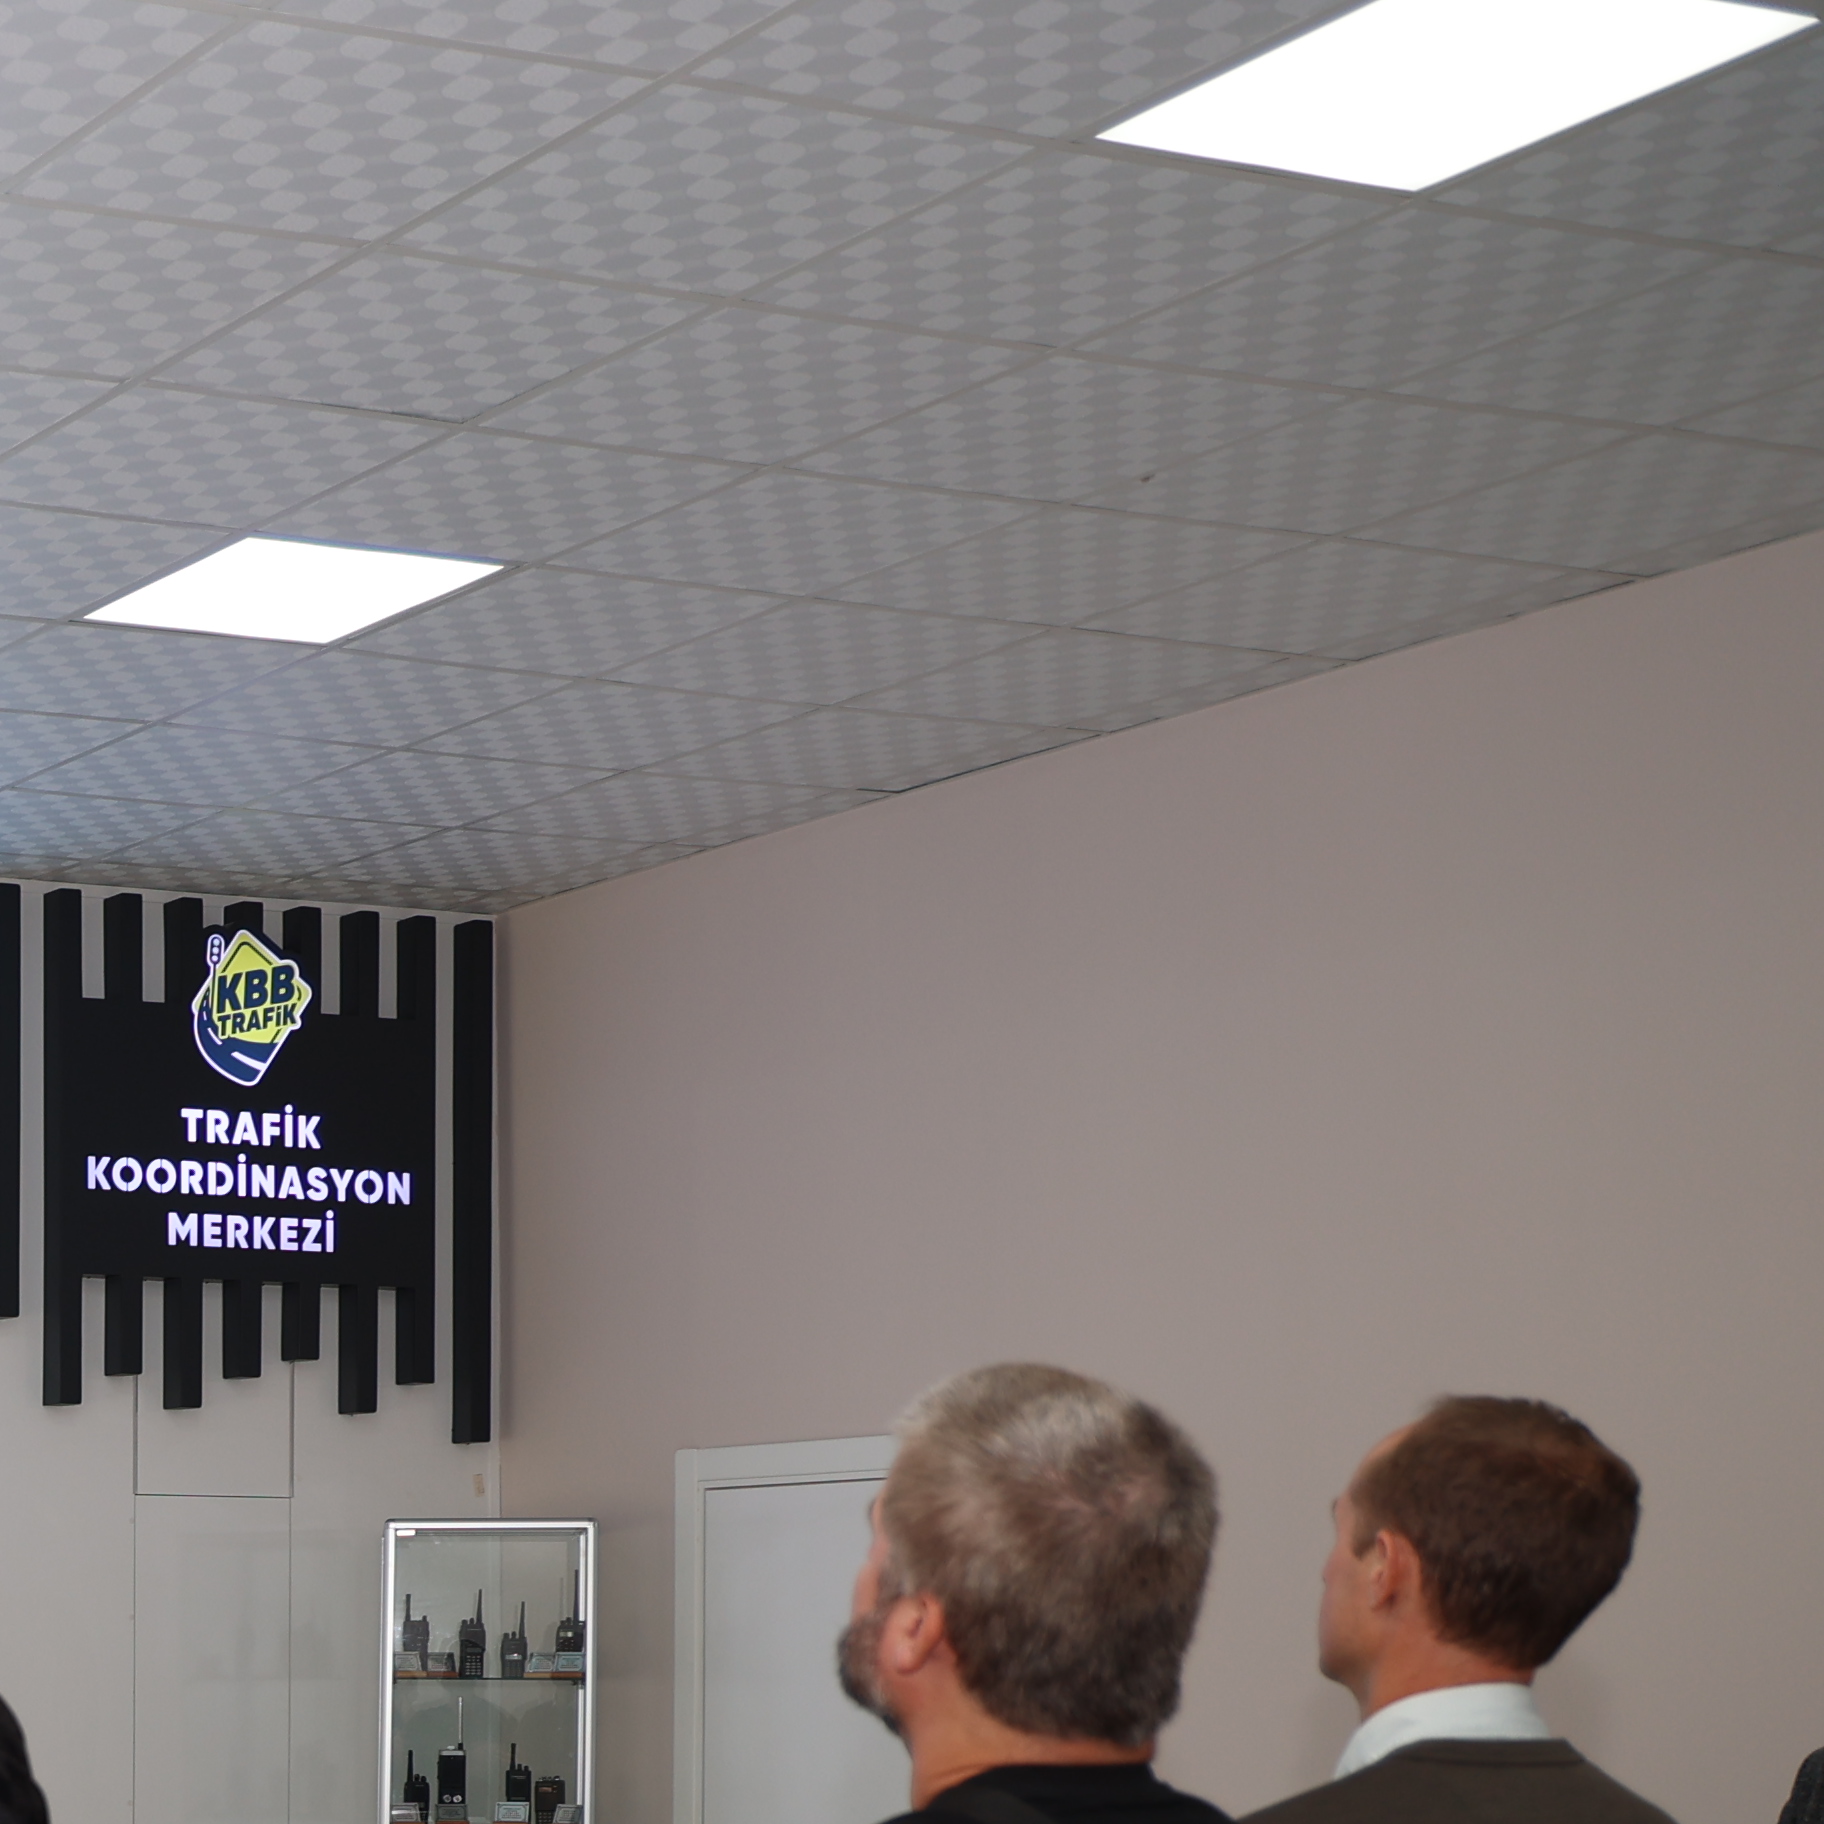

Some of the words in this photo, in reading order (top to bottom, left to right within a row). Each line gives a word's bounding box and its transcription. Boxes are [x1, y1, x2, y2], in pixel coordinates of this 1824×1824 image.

[216, 964, 297, 1014] KBB
[181, 1104, 321, 1150] TRAFİK
[87, 1153, 411, 1205] KOORDİNASYON
[167, 1209, 335, 1253] MERKEZİ
